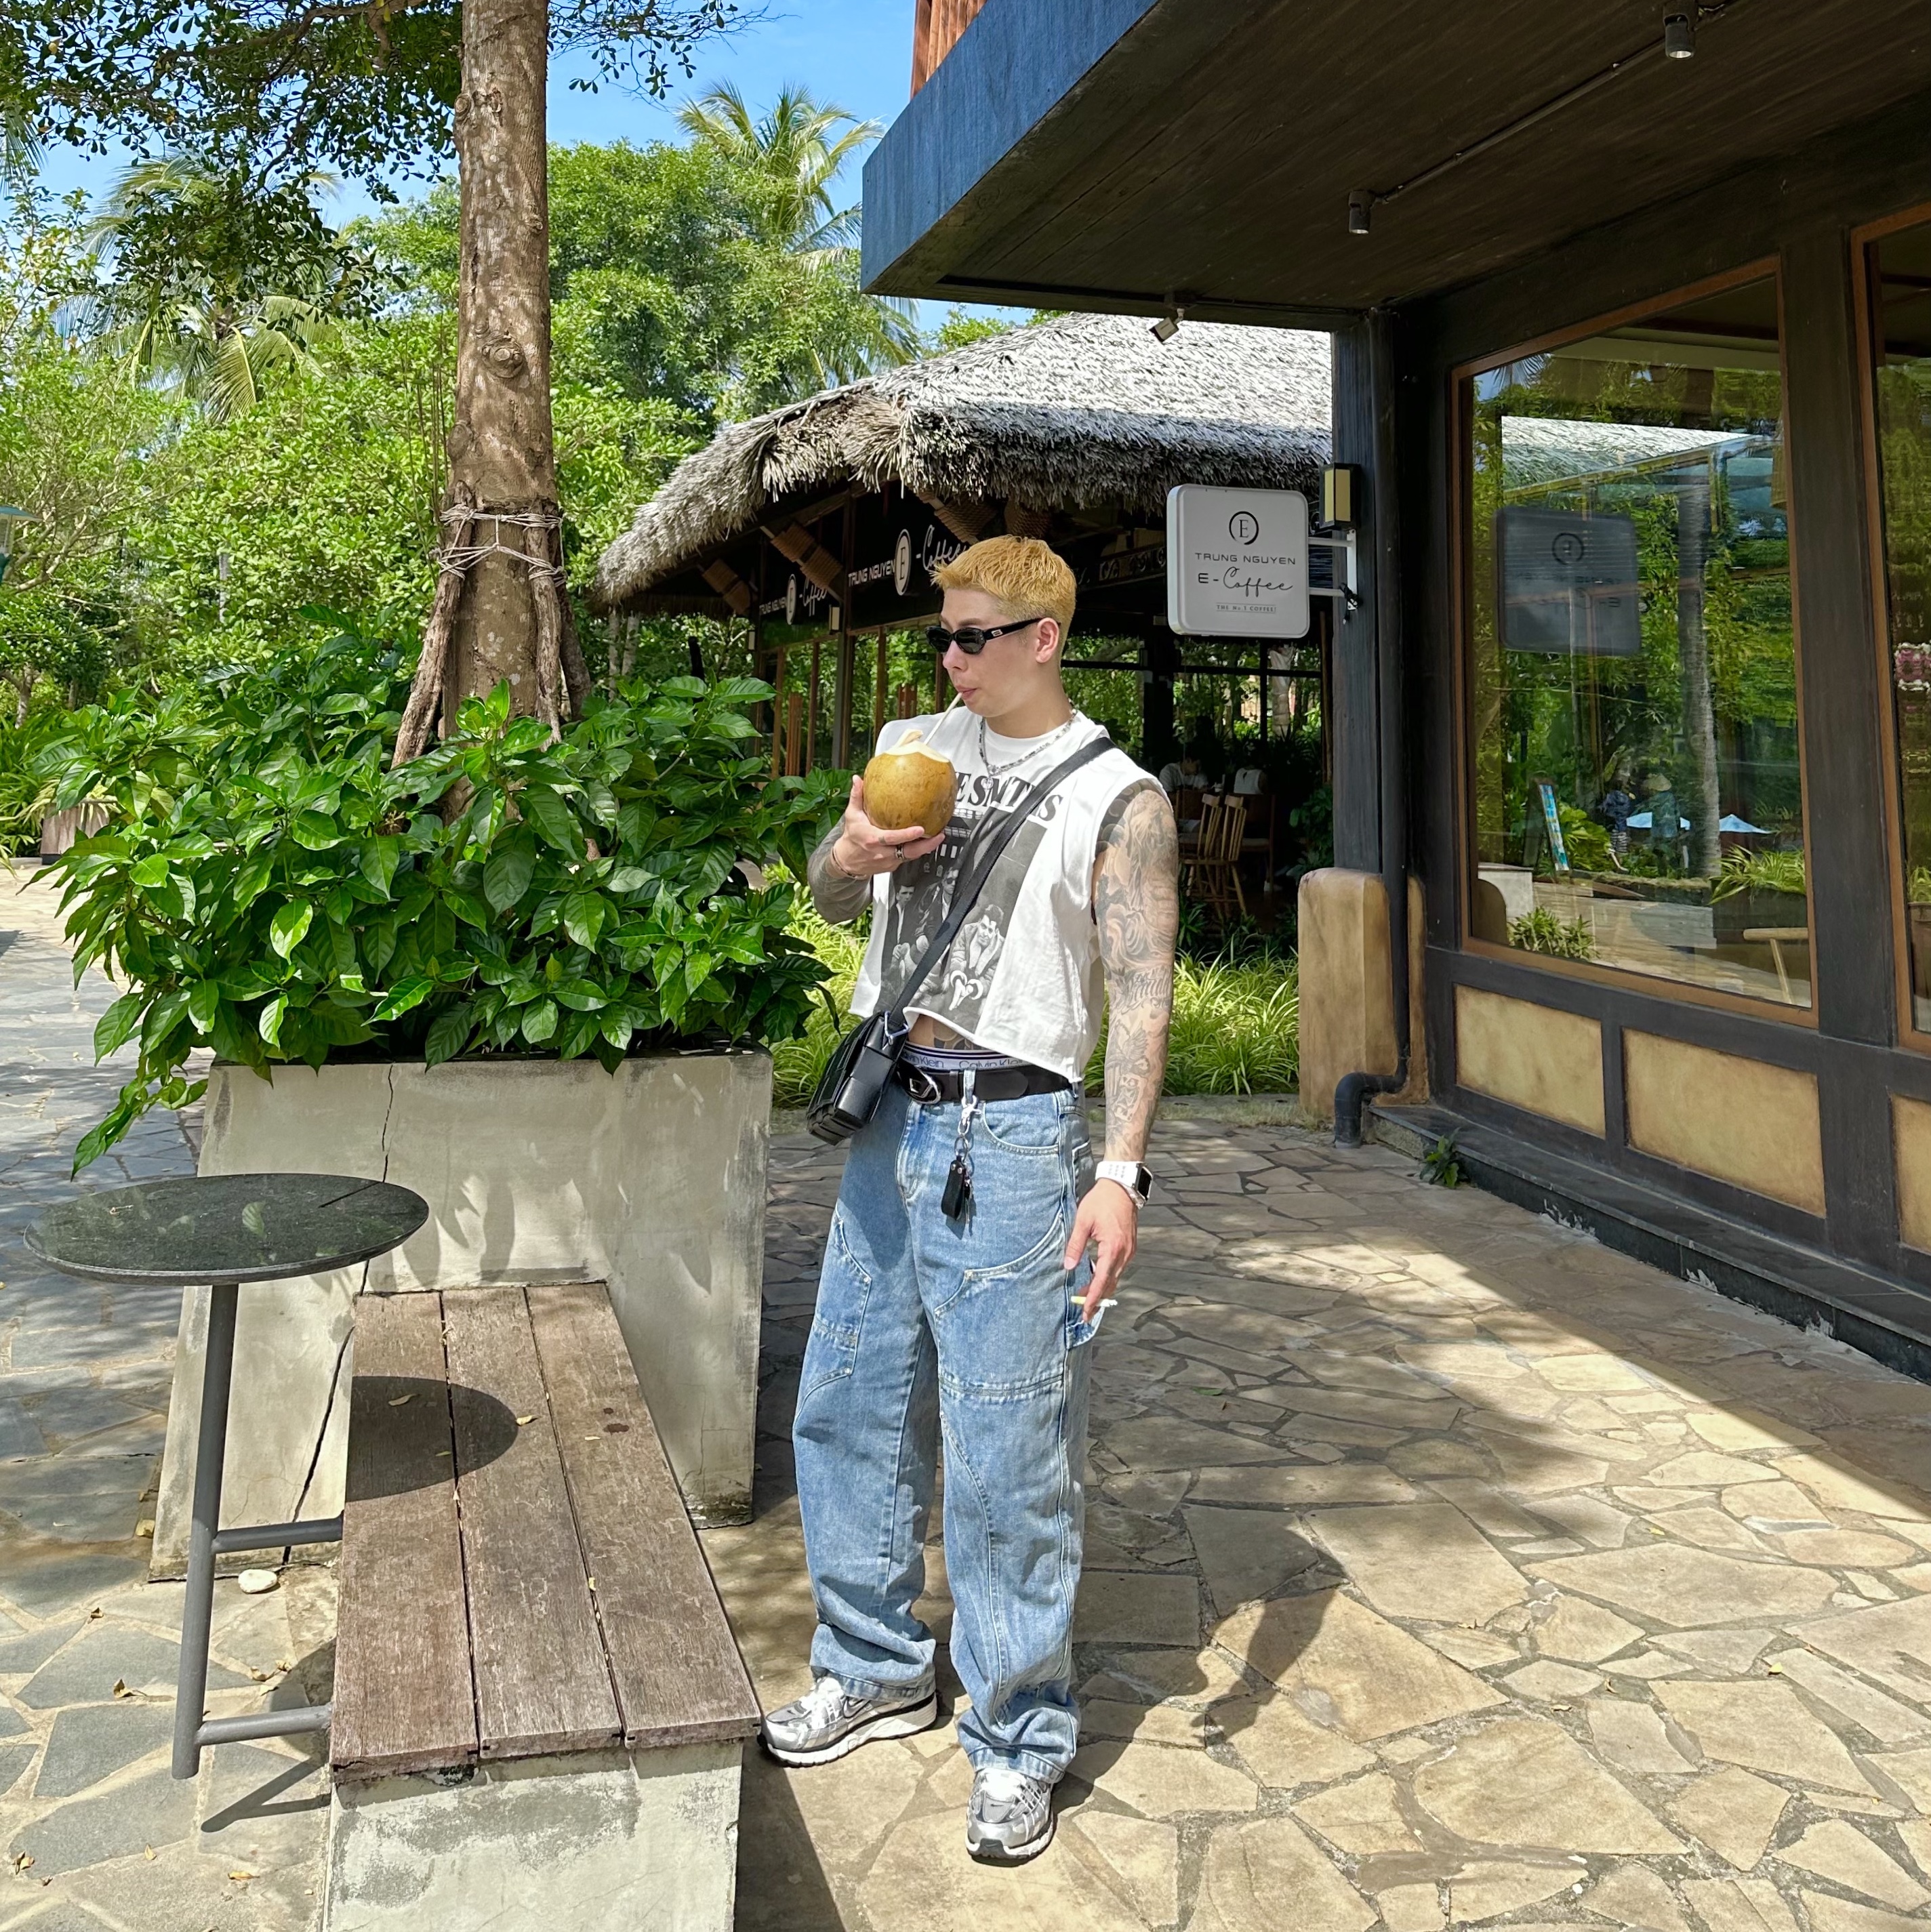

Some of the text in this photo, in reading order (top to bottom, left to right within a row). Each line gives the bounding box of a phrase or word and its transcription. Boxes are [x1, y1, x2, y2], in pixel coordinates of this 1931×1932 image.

[1239, 519, 1249, 538] E
[1195, 552, 1296, 565] TRUNG NGUYEN
